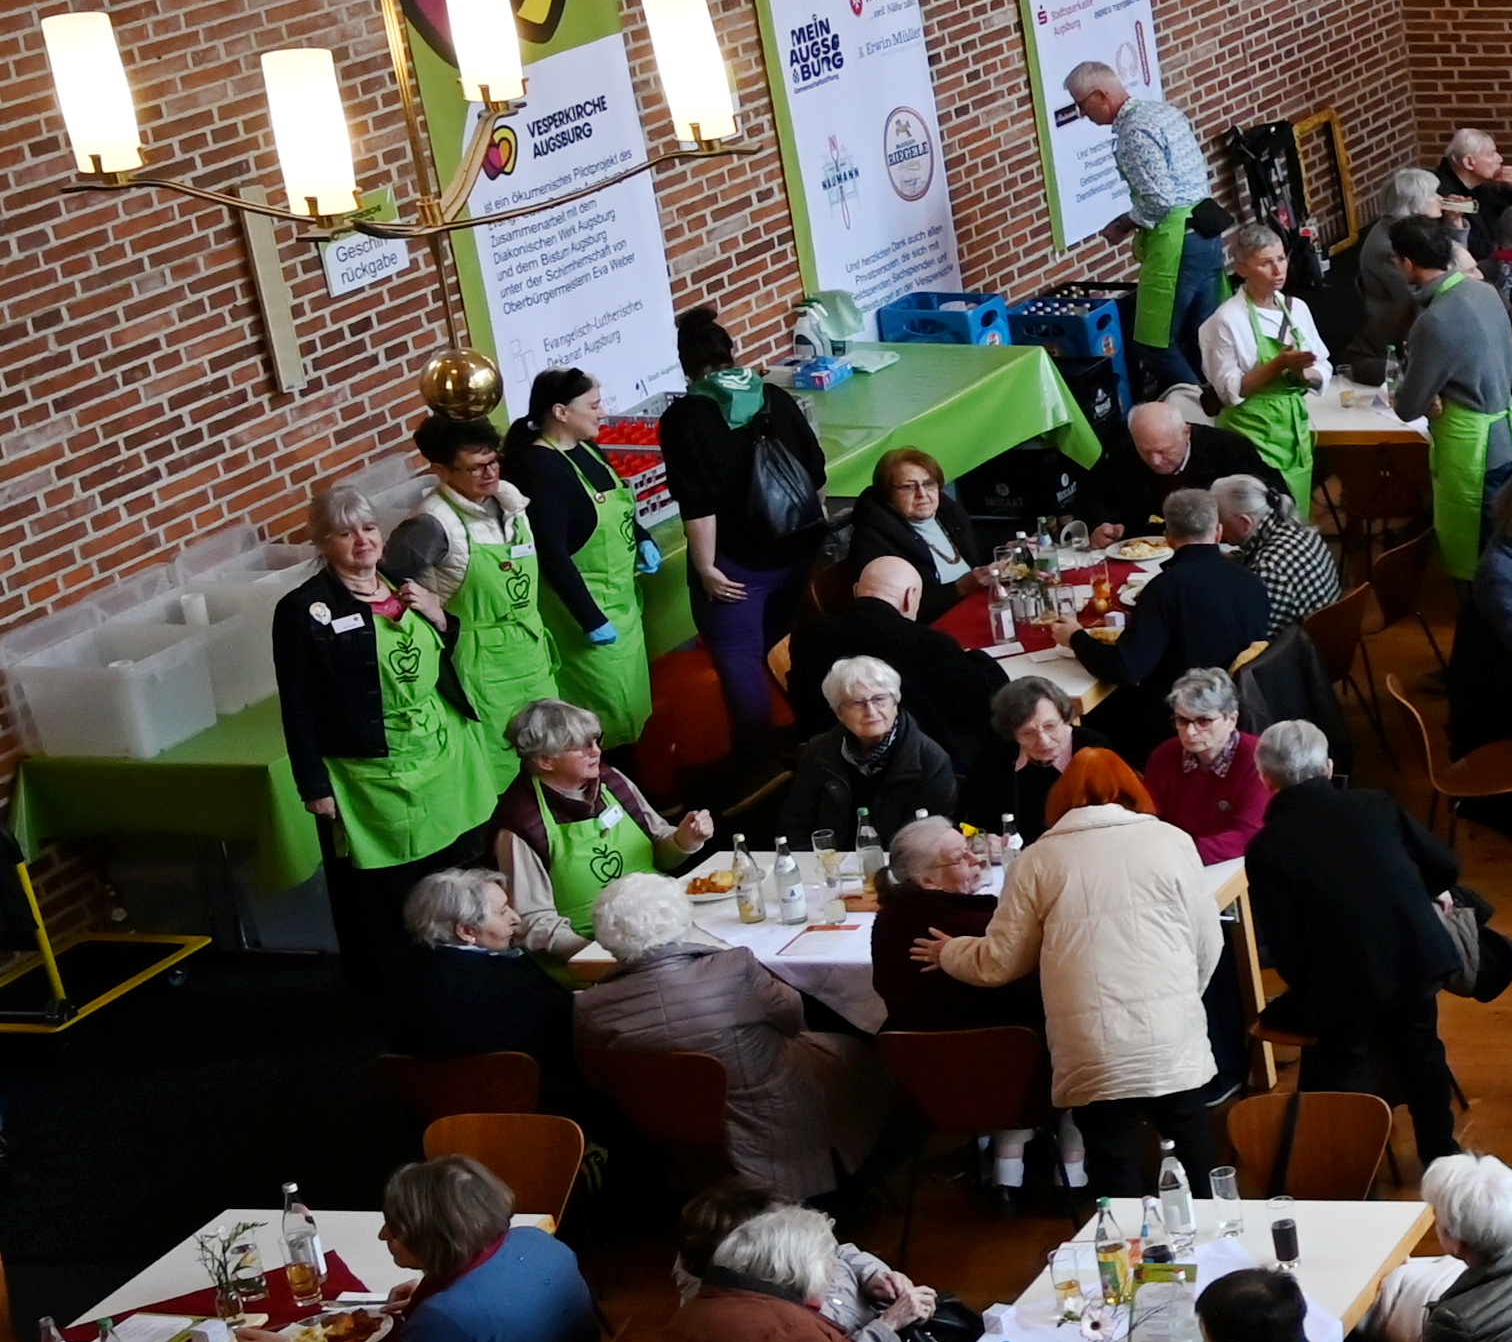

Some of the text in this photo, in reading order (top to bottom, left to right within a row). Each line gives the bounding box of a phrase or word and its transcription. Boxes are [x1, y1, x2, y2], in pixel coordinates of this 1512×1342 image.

[791, 14, 830, 47] MEIN
[800, 51, 844, 82] BURG
[526, 95, 608, 139] VESPERKIRCHE
[533, 122, 593, 160] AUGSBURG
[888, 141, 929, 167] RIEGELE
[821, 167, 860, 191] NAUMANN
[494, 196, 509, 210] ein
[493, 234, 558, 265] Diakonischen
[578, 209, 616, 231] Augsburg
[341, 253, 398, 285] rückgabe
[497, 266, 514, 282] und
[516, 259, 539, 275] dem
[609, 252, 636, 272] Weber
[500, 281, 523, 299] unter
[526, 273, 543, 289] der
